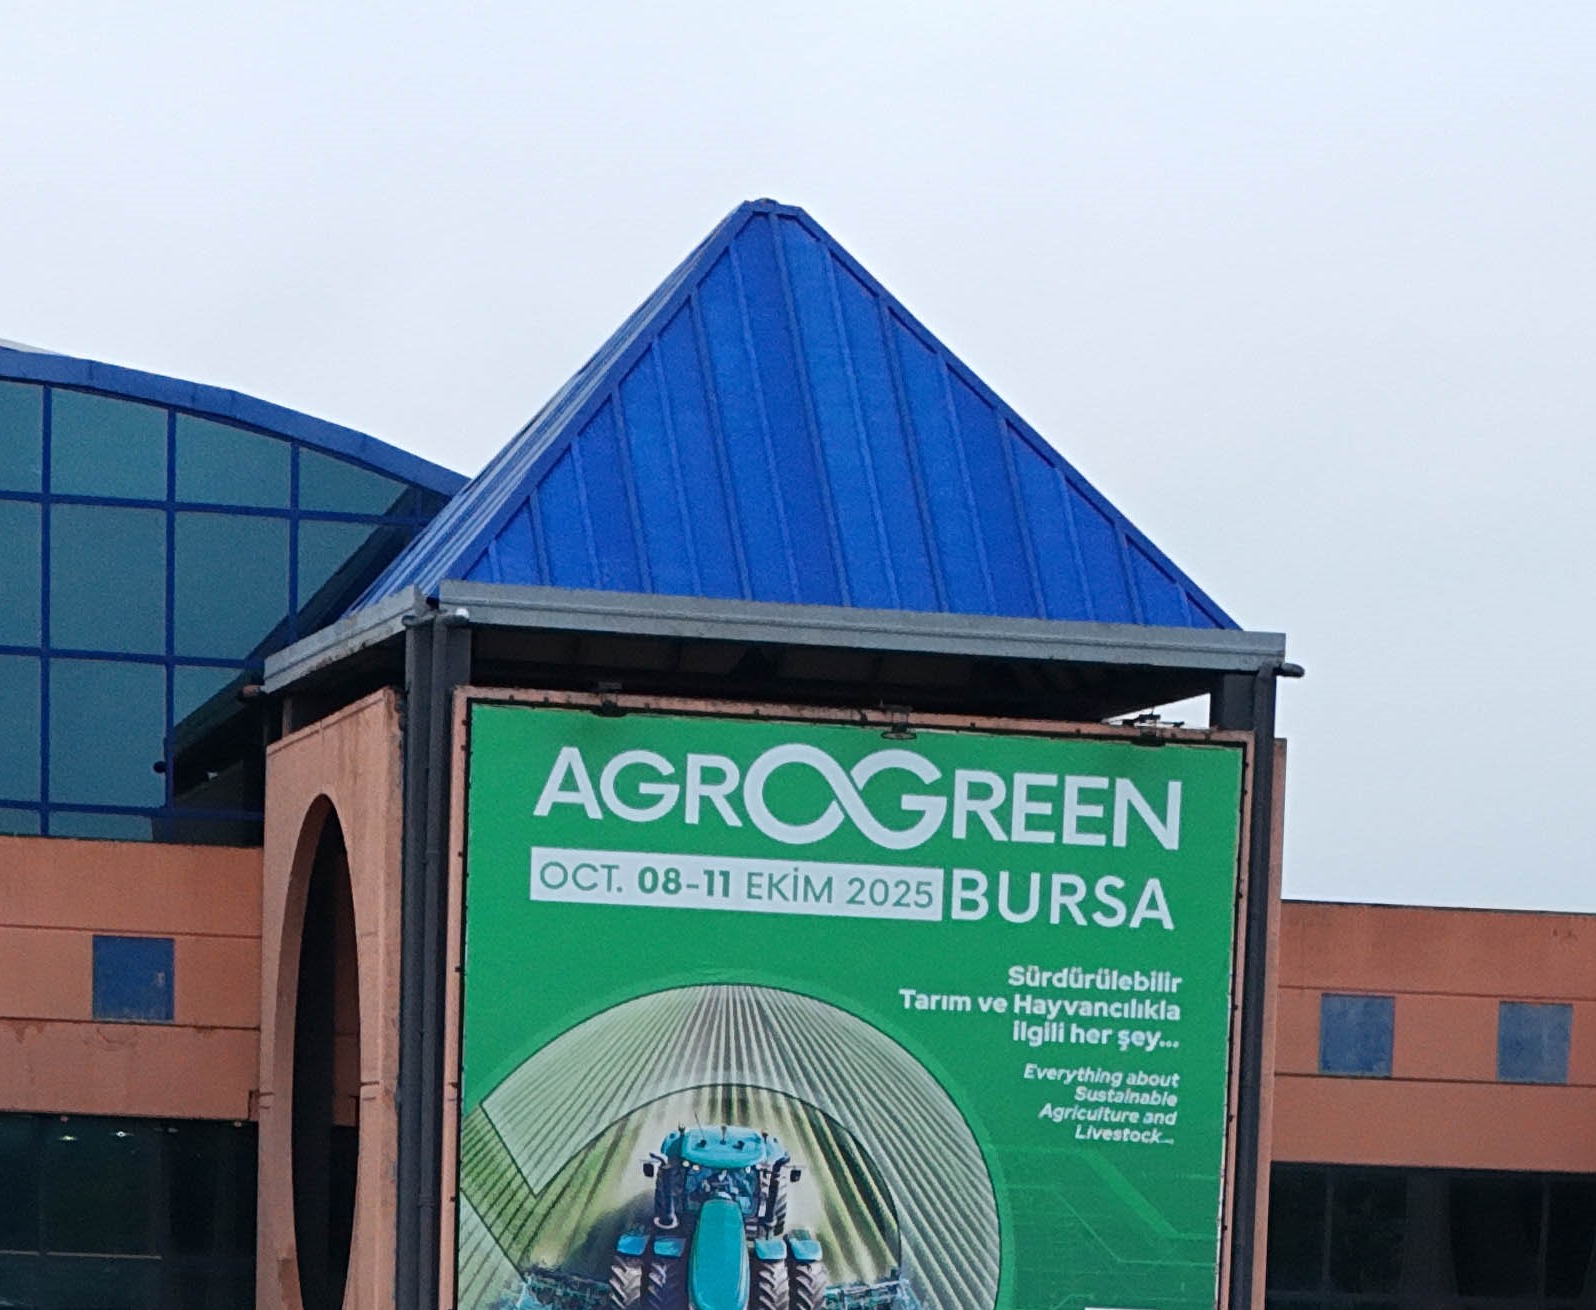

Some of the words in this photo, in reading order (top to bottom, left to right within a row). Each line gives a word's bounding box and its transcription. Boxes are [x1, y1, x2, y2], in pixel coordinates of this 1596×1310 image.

[532, 742, 1181, 852] AGROGREEN
[539, 862, 624, 893] OCT.
[637, 866, 730, 898] 08-11
[746, 866, 834, 903] EKİM
[847, 877, 934, 909] 2025
[950, 868, 1176, 931] BURSA
[1007, 964, 1182, 995] Sürdürülebilir
[898, 989, 974, 1013] Tarım
[979, 998, 1008, 1014] ve
[1012, 994, 1182, 1023] Hayvancılıkla
[1012, 1020, 1065, 1045] ilgili
[1070, 1021, 1112, 1044] her
[1118, 1028, 1179, 1052] şey...
[1023, 1063, 1122, 1087] Everything
[1127, 1070, 1179, 1087] about
[1074, 1086, 1178, 1106] Sustainable
[1039, 1104, 1139, 1125] Agriculture
[1144, 1109, 1177, 1125] and
